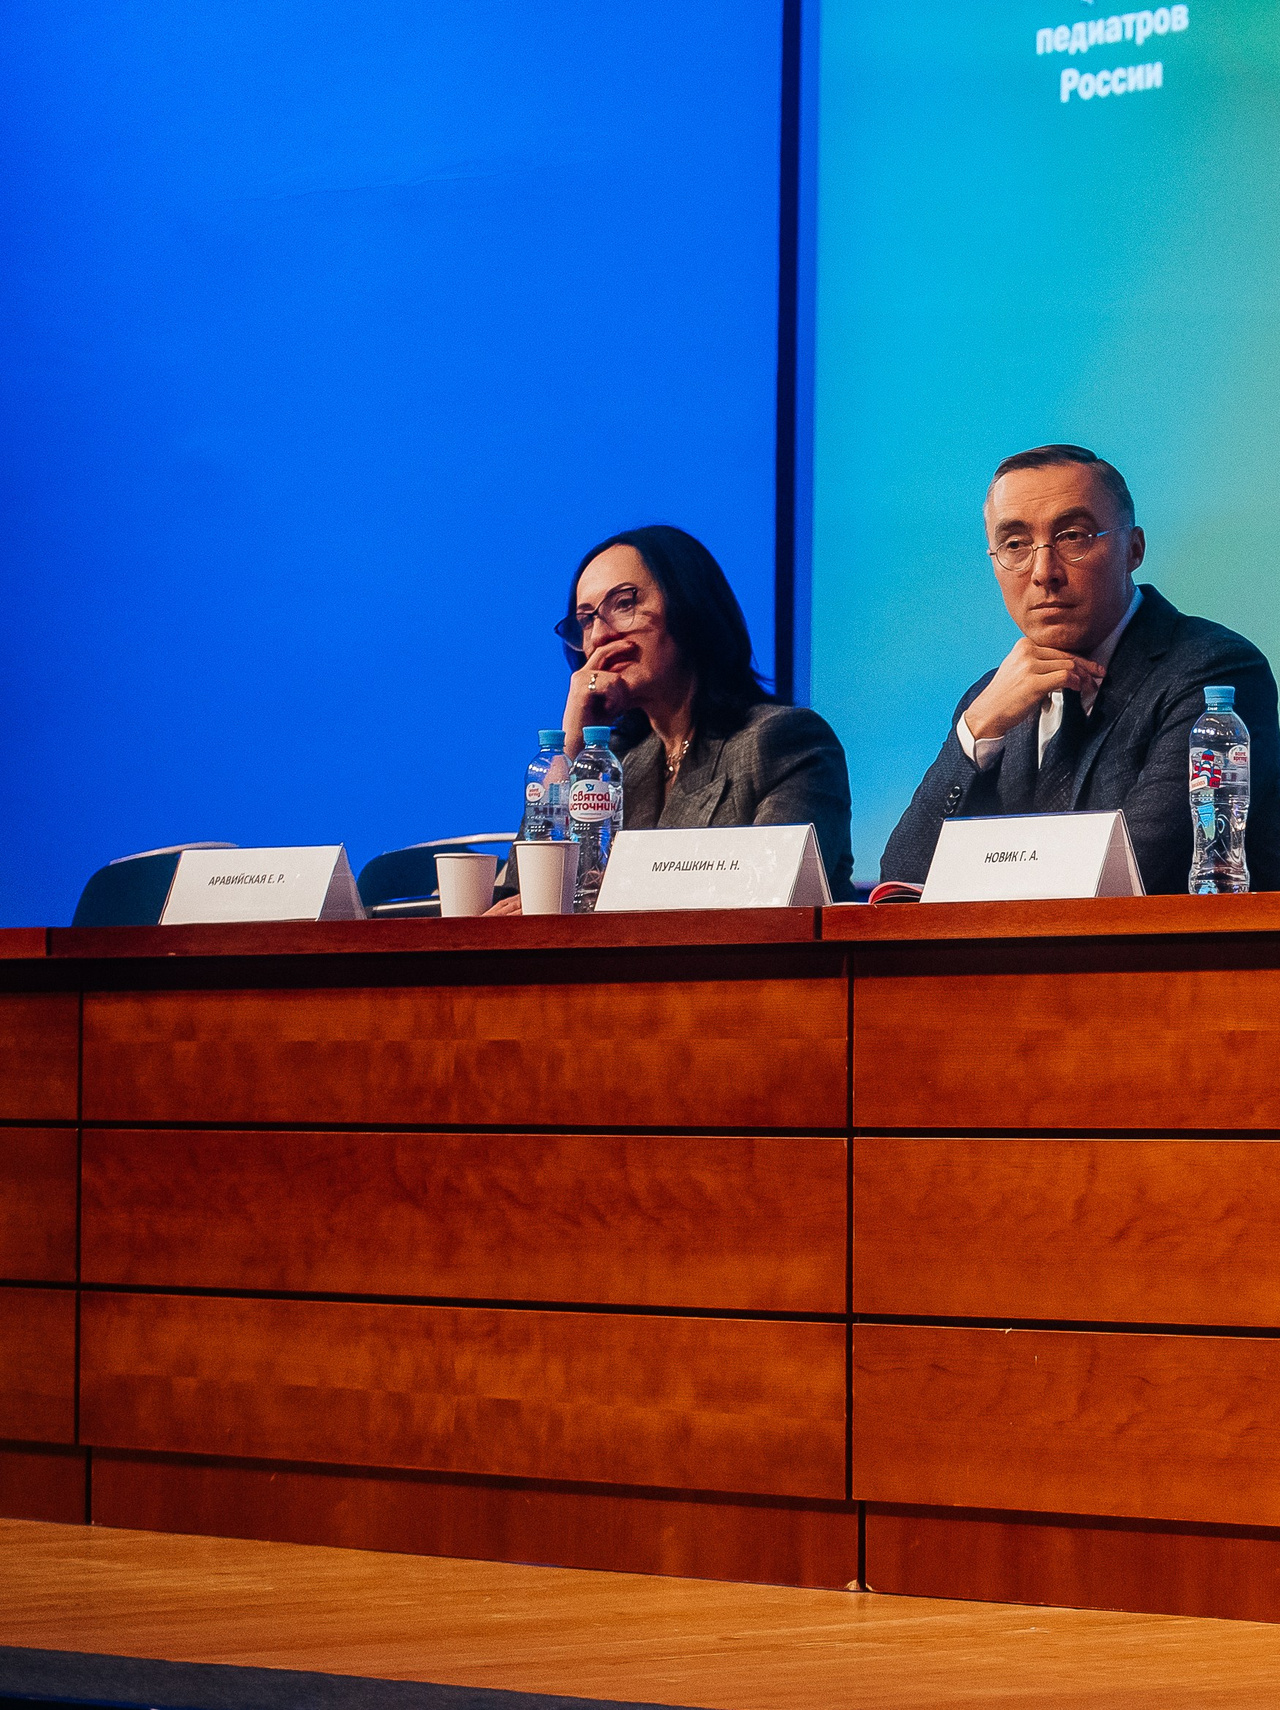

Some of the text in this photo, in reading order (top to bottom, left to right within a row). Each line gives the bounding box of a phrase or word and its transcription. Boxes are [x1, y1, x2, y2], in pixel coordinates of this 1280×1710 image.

[1036, 4, 1189, 55] педиатров
[1060, 61, 1163, 103] России
[984, 849, 1039, 864] НОВИК Г. А.
[651, 859, 740, 872] МУРАШКИН Н. Н.
[208, 873, 285, 885] АРАВИЙСКАЯ Е. Р.
